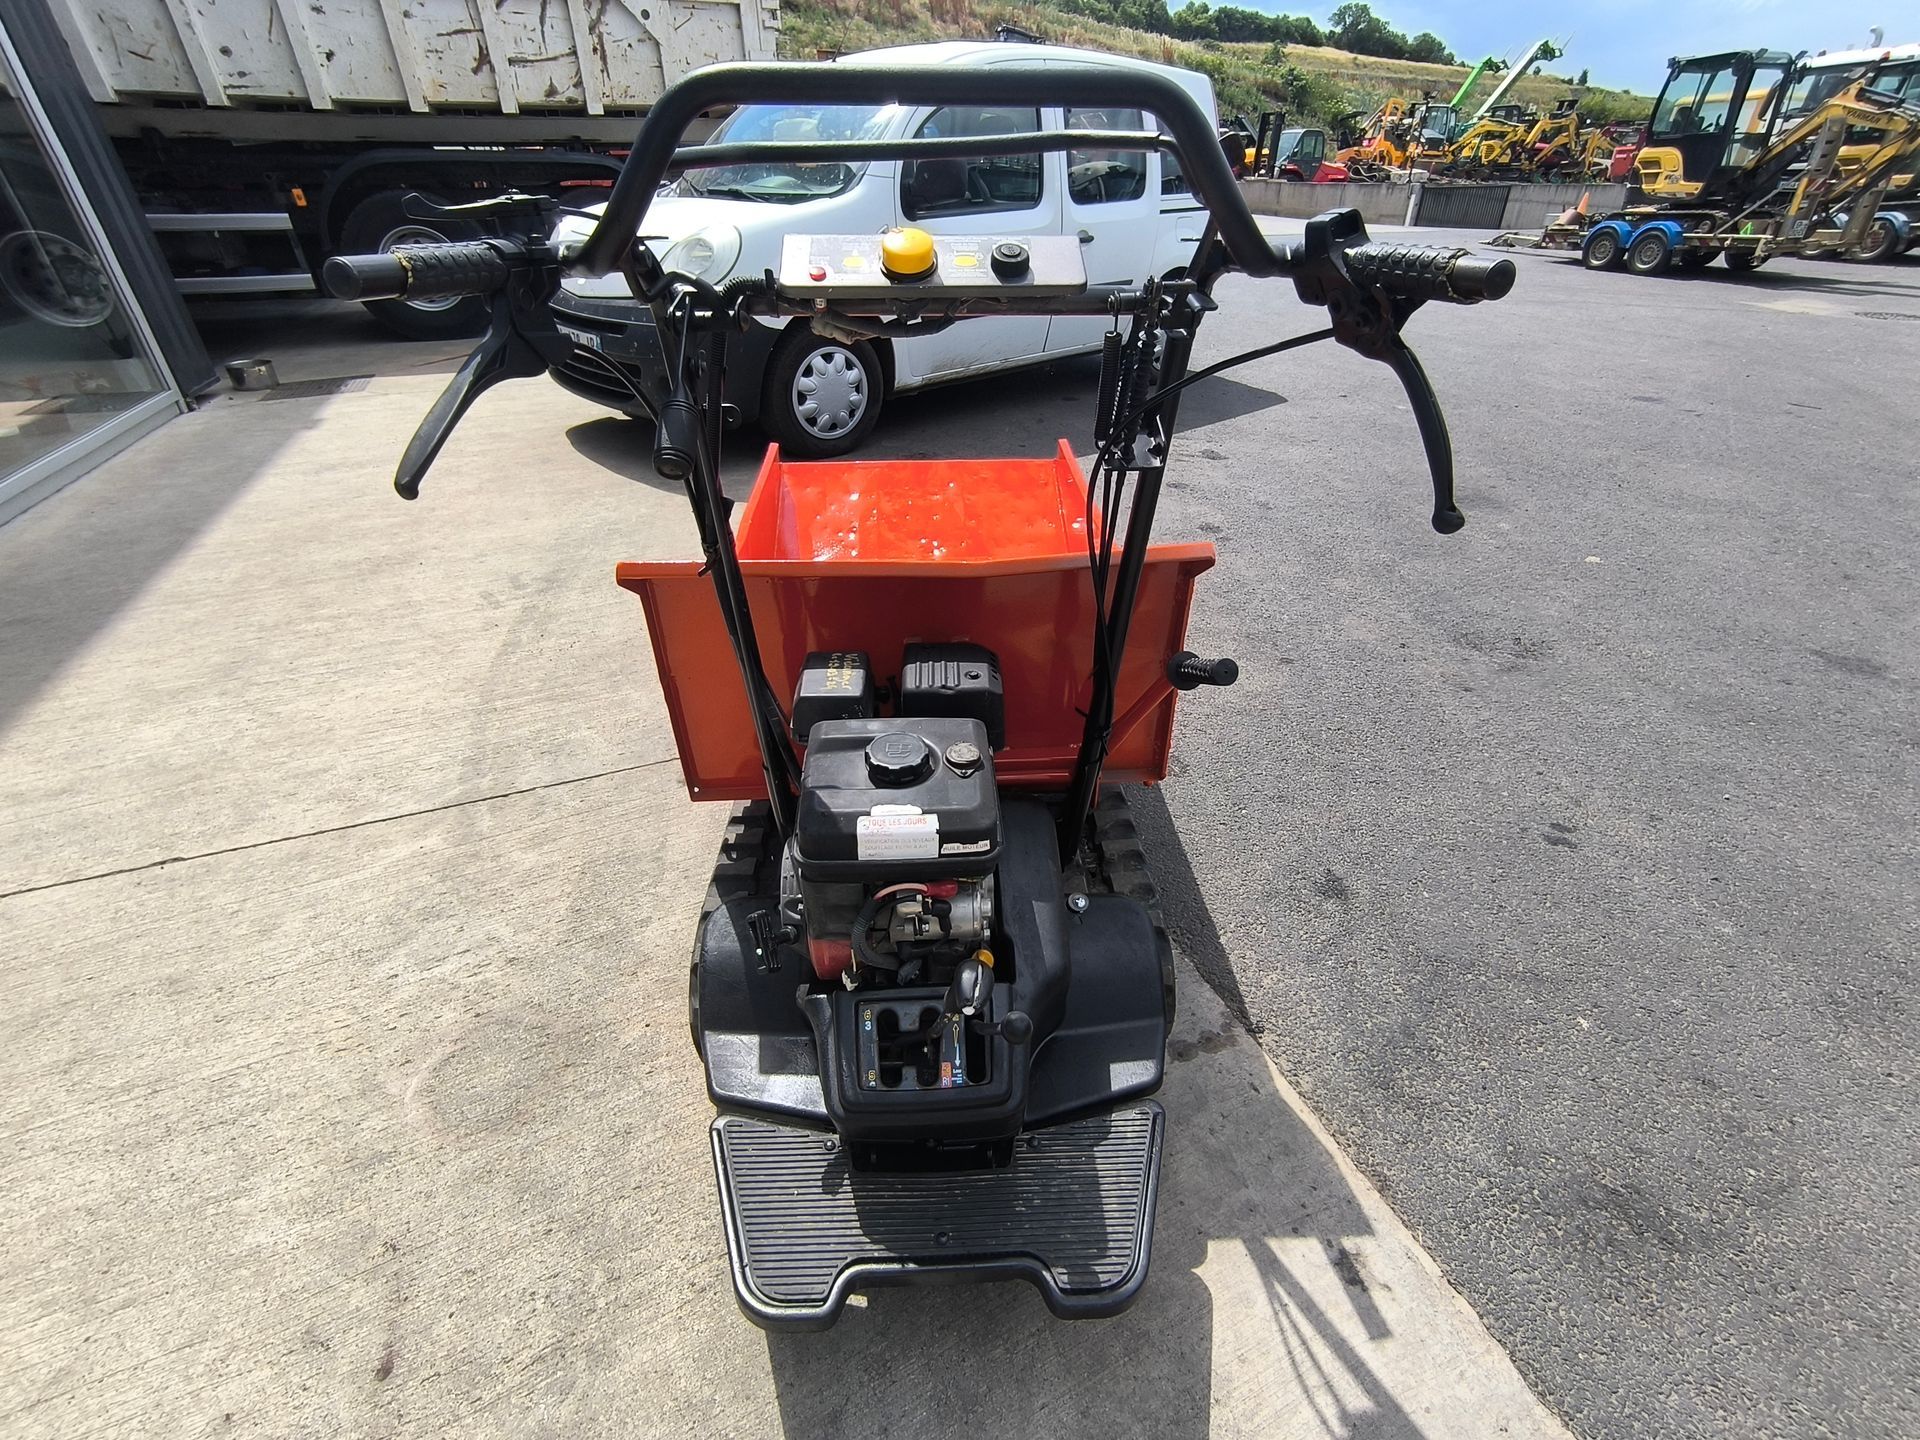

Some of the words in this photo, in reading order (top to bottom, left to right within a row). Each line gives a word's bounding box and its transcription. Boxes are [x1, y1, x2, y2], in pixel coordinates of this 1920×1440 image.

[1847, 109, 1882, 125] YANMAR
[868, 818, 886, 827] TOUS
[889, 818, 902, 826] LES
[903, 817, 928, 826] JOURS
[863, 1010, 871, 1021] 6
[864, 1021, 872, 1031] 3
[868, 1069, 876, 1081] 5
